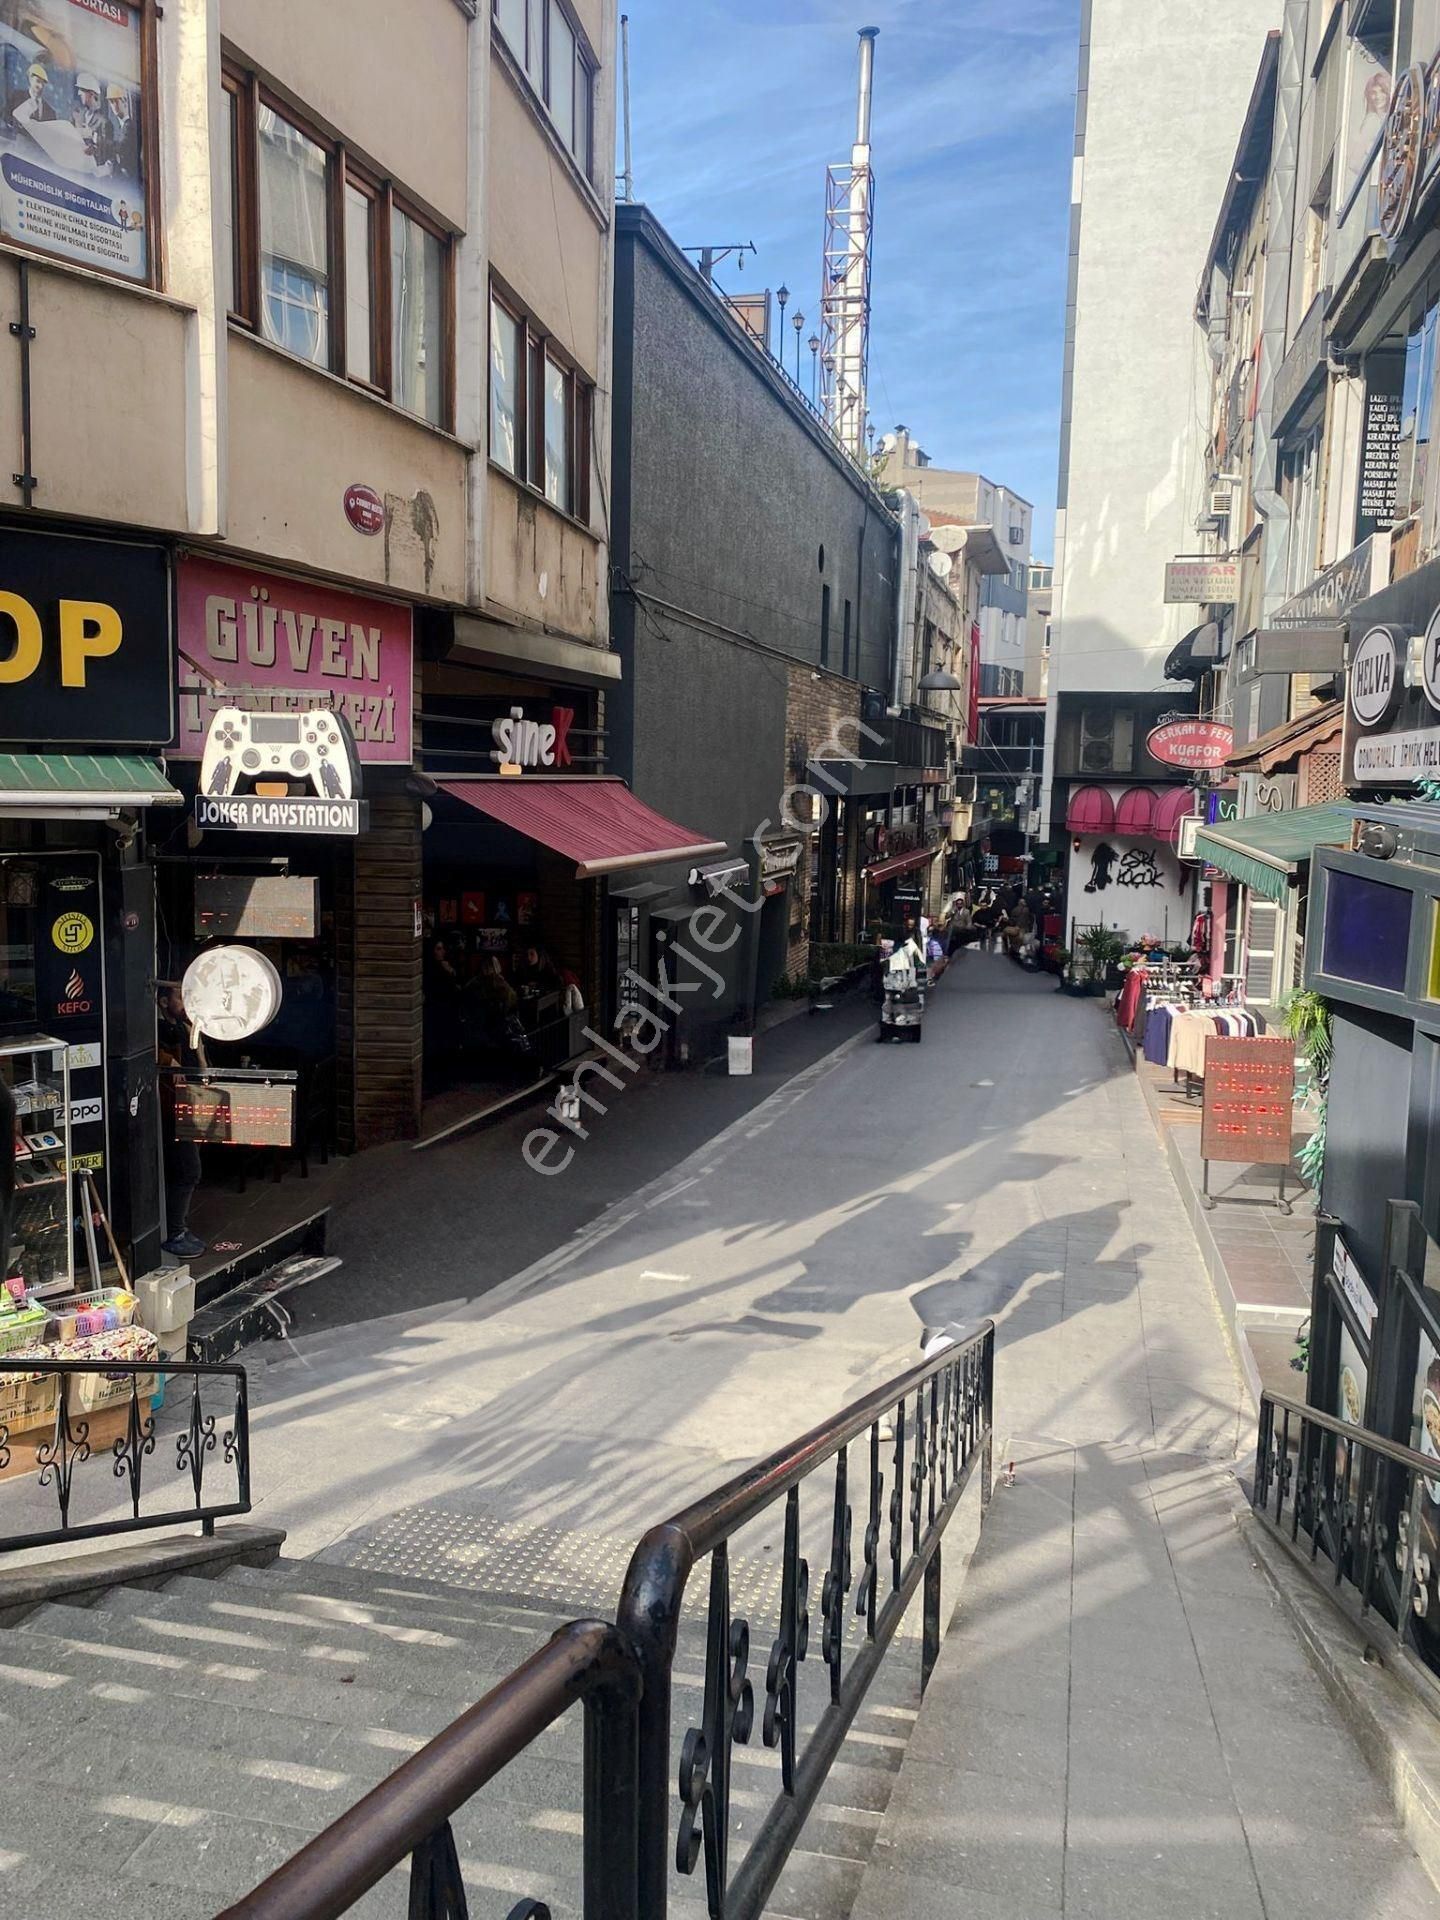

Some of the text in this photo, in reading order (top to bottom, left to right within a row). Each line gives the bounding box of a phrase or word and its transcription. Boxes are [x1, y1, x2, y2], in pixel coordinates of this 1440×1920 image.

[11, 172, 111, 216] MÜHENDİSLİK SİGORTALARI
[1367, 431, 1390, 441] KERATİN
[1366, 442, 1389, 450] BONCUK
[1365, 460, 1388, 469] KERATİN
[1363, 470, 1391, 478] PORSELEN
[1363, 480, 1386, 489] MASAJLI
[1363, 489, 1385, 498] MASAJLI
[1361, 506, 1387, 516] TESETTÜR
[206, 585, 382, 682] GÜVEN
[1356, 652, 1390, 698] HELVA
[1155, 724, 1195, 743] SERKAN
[1199, 726, 1206, 735] &
[1423, 740, 1440, 766] HEL
[200, 801, 353, 828] JOKER PLAYSTATION
[57, 1001, 90, 1014] KEFO
